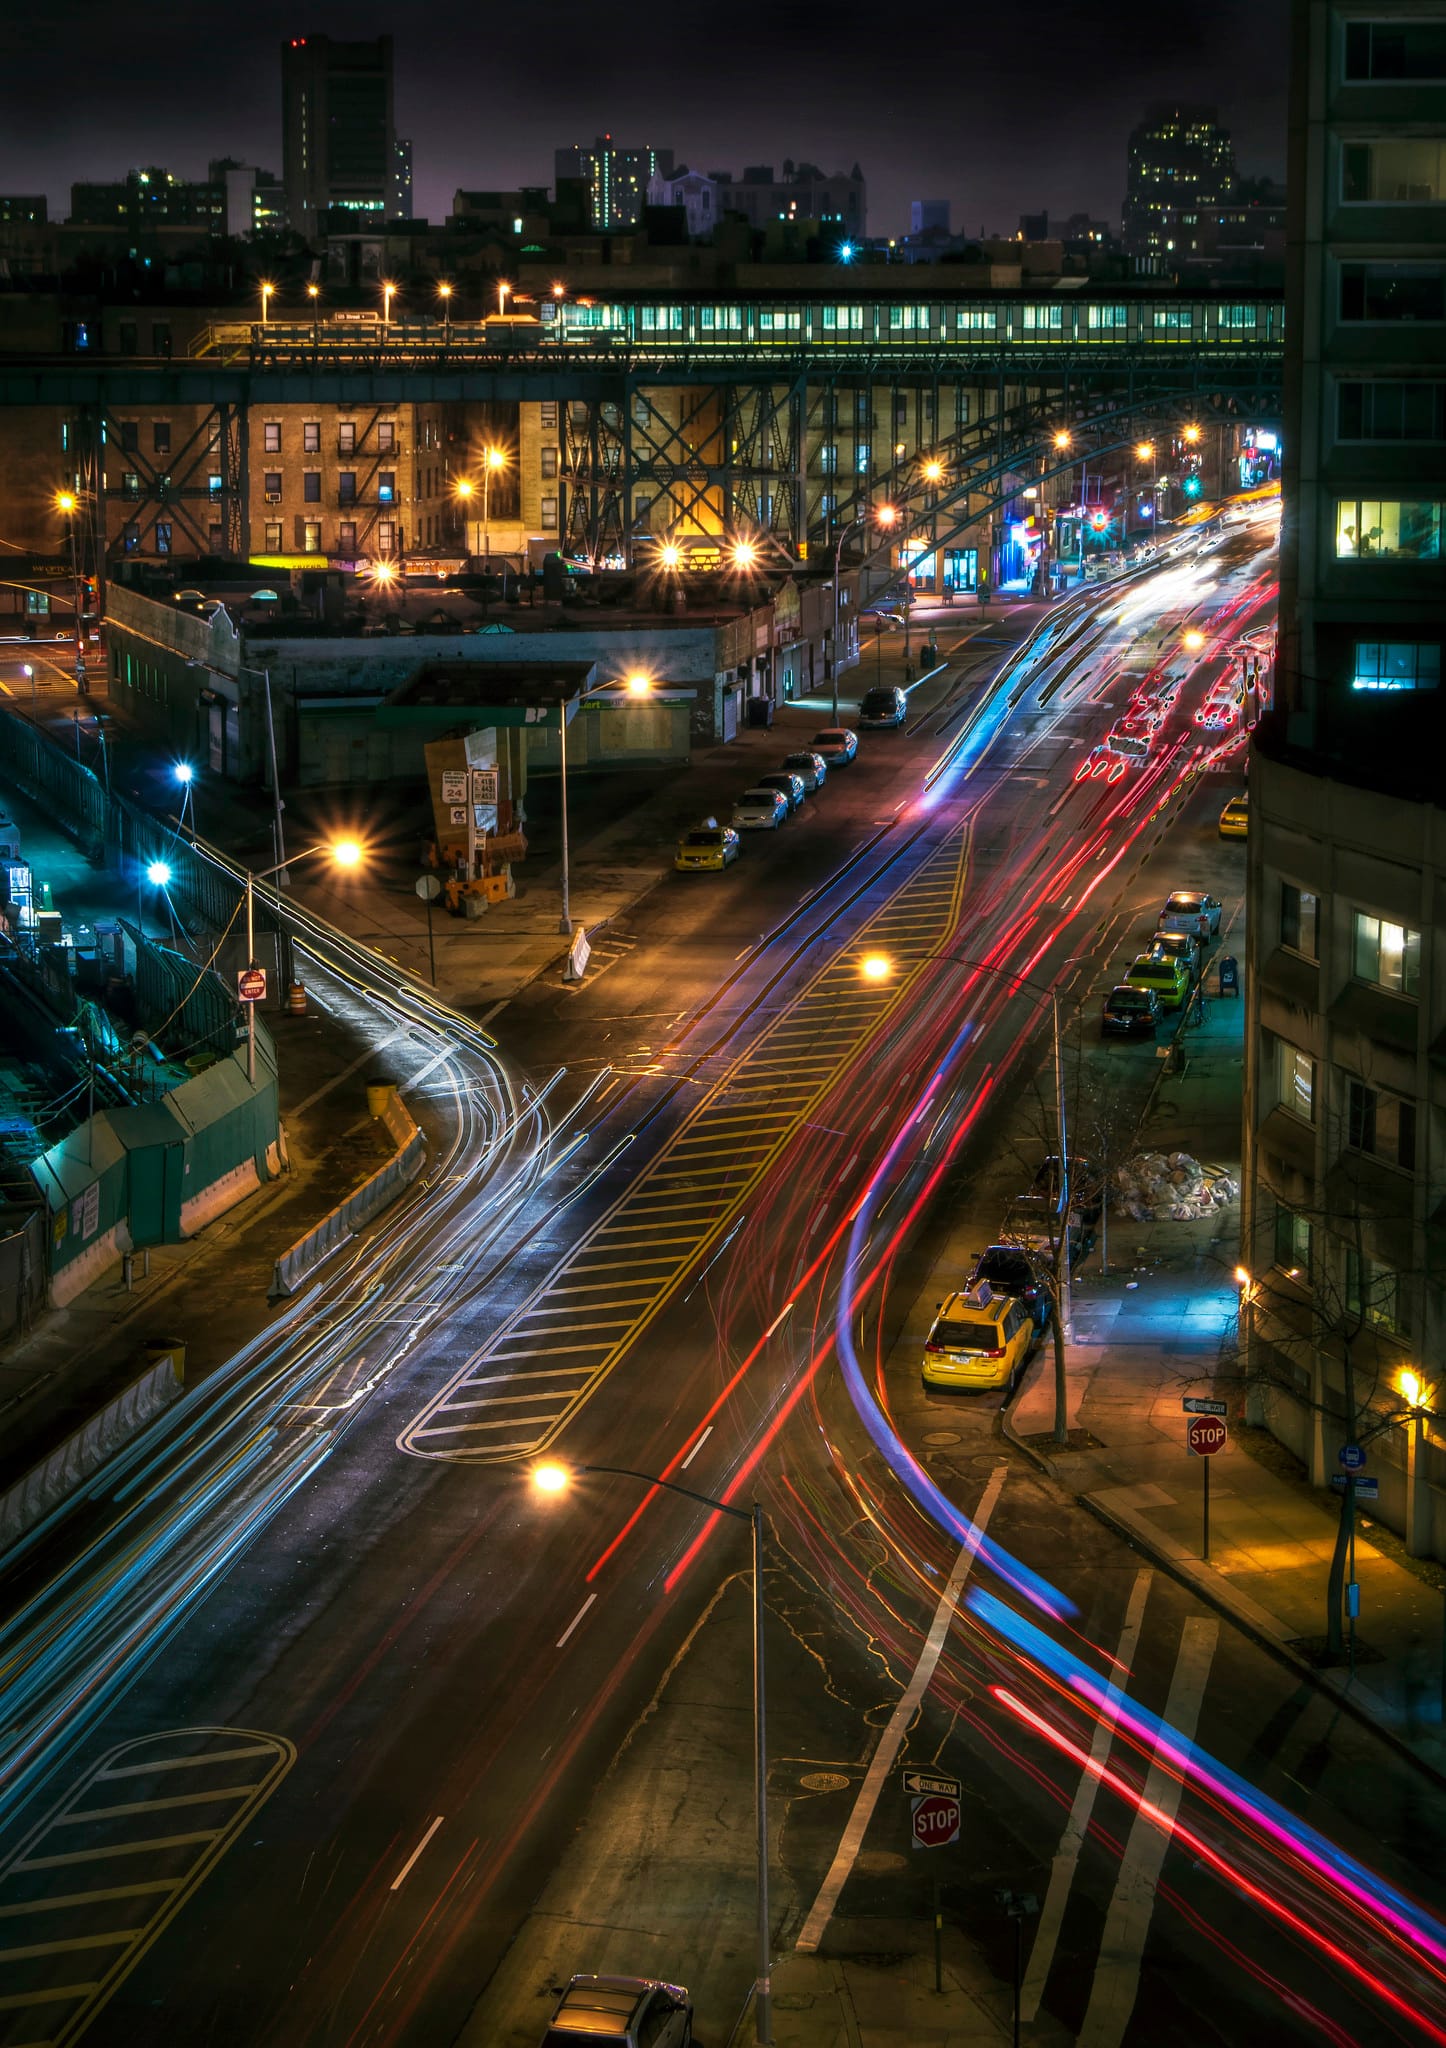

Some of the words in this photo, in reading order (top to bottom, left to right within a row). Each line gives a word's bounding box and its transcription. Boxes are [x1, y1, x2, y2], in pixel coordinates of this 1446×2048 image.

[524, 707, 548, 723] BP
[447, 789, 462, 797] 24
[1191, 1428, 1224, 1445] STOP
[919, 1779, 934, 1790] ONE
[938, 1783, 955, 1793] WAY
[918, 1809, 957, 1832] STOP
